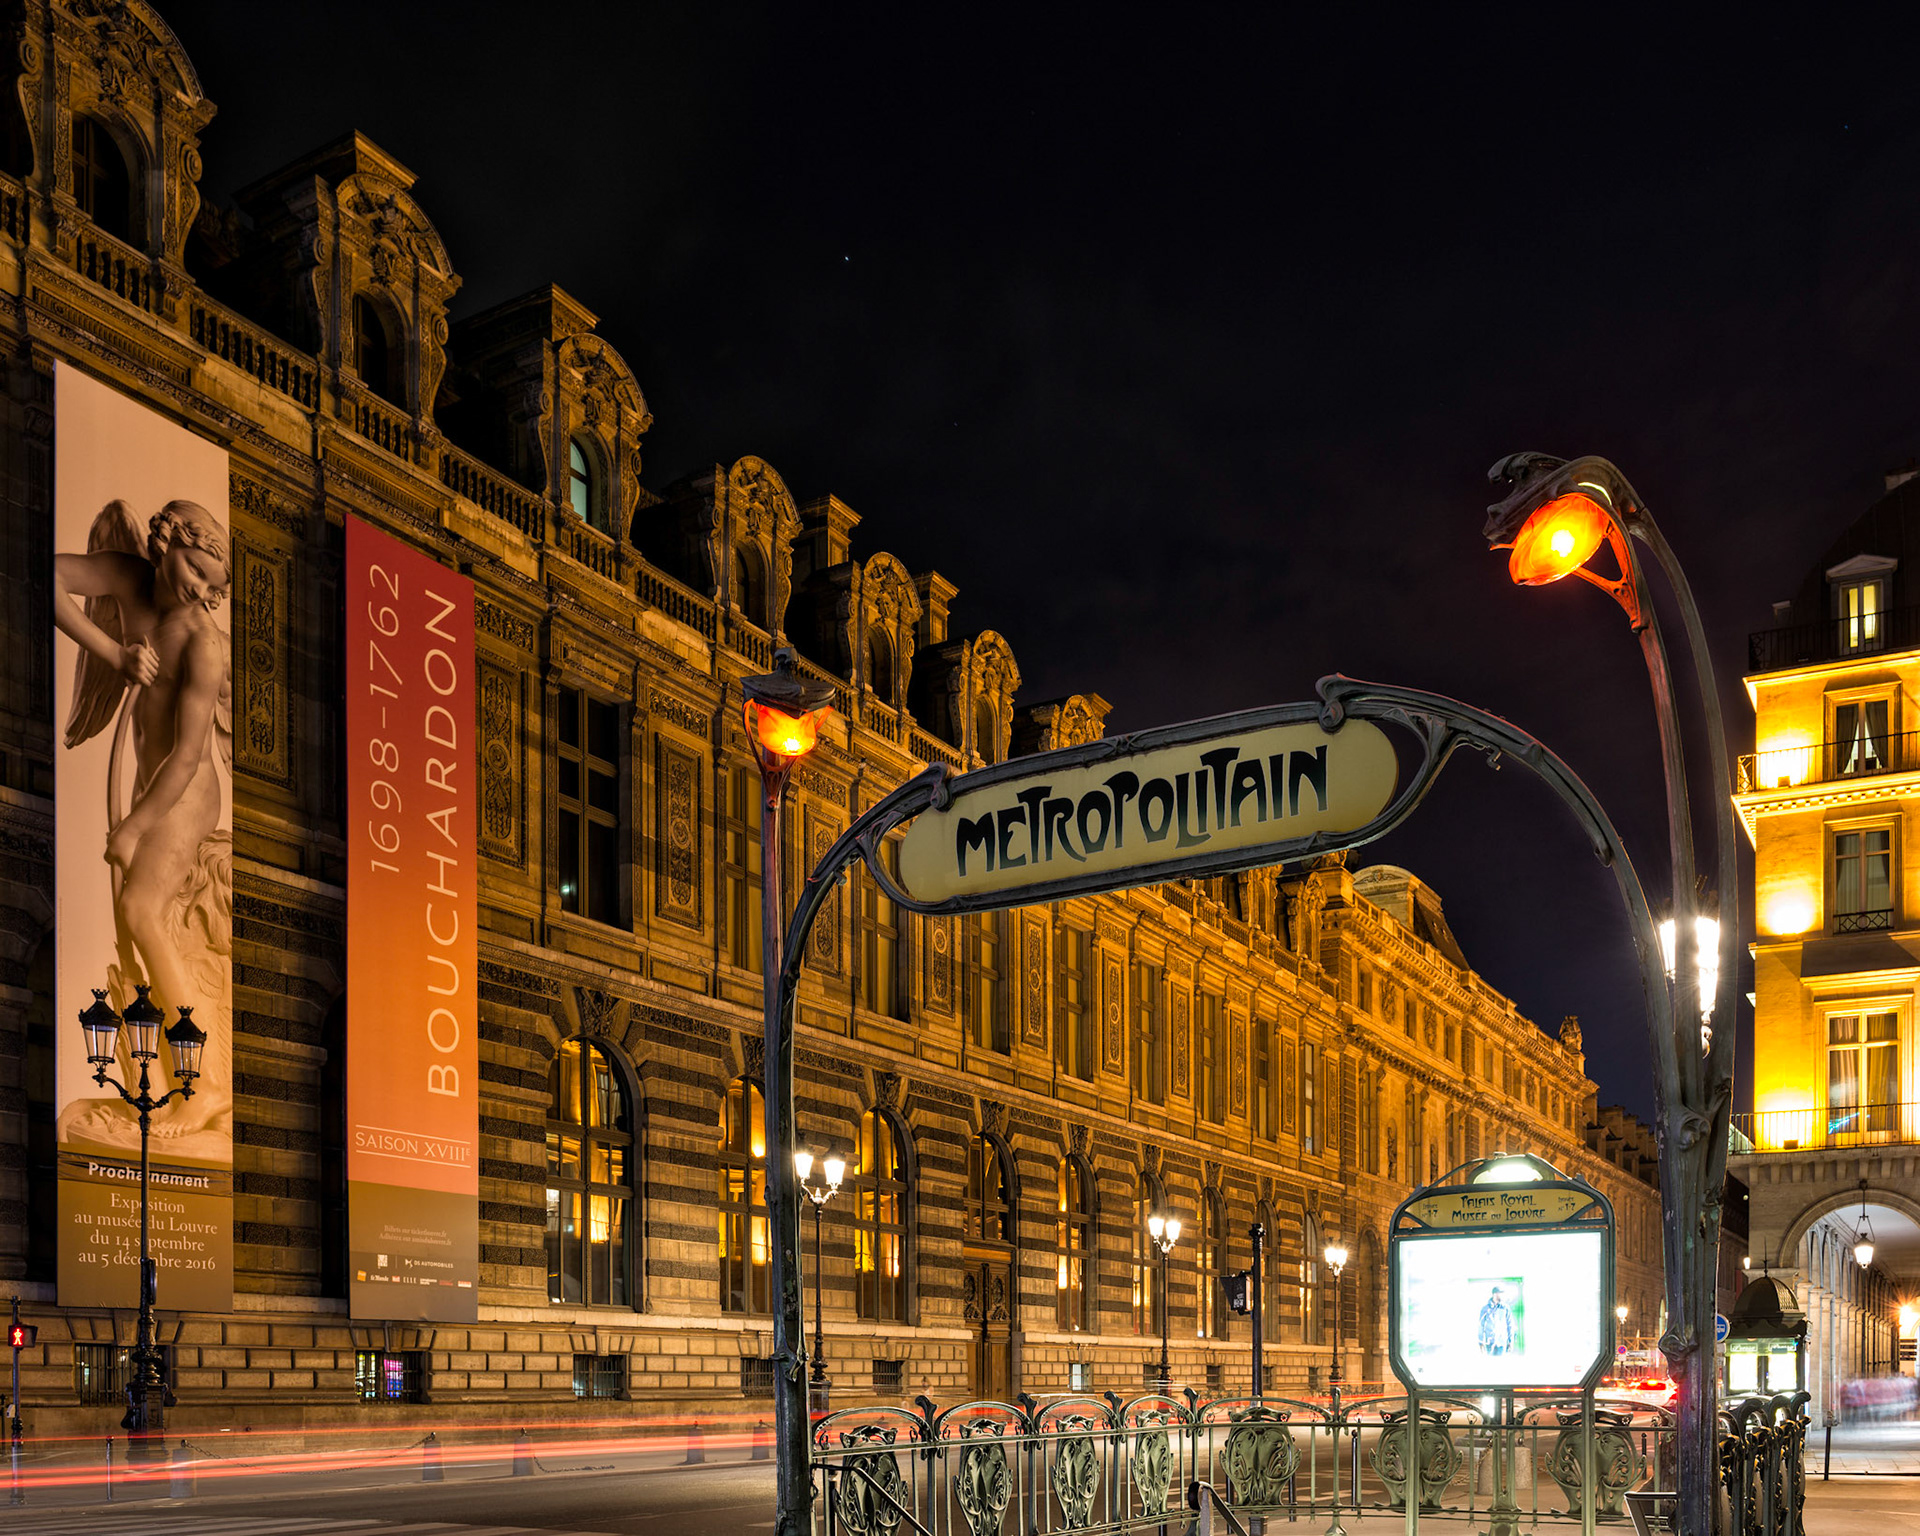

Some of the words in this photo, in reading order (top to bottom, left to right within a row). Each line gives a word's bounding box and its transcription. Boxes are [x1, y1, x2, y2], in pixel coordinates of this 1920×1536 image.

[368, 564, 402, 873] 1698-1762
[956, 744, 1328, 877] METROPOLITAIN
[424, 589, 460, 1097] BOUCHARDON
[355, 1132, 418, 1154] SAISON
[88, 1162, 209, 1188] Prochanement
[110, 1193, 185, 1213] Expsition
[1460, 1195, 1495, 1208] PALAIS
[1500, 1193, 1537, 1207] ROYAL
[74, 1213, 92, 1224] au
[97, 1214, 142, 1229] musée
[169, 1217, 218, 1235] Louvre
[1506, 1207, 1546, 1221] LOUVRE
[90, 1229, 109, 1245] du
[116, 1236, 130, 1250] 14
[134, 1236, 205, 1252] sptembre
[78, 1252, 97, 1263] au
[101, 1254, 109, 1268] 5
[185, 1256, 216, 1270] 2016
[421, 1261, 454, 1269] AUTOMOBILES
